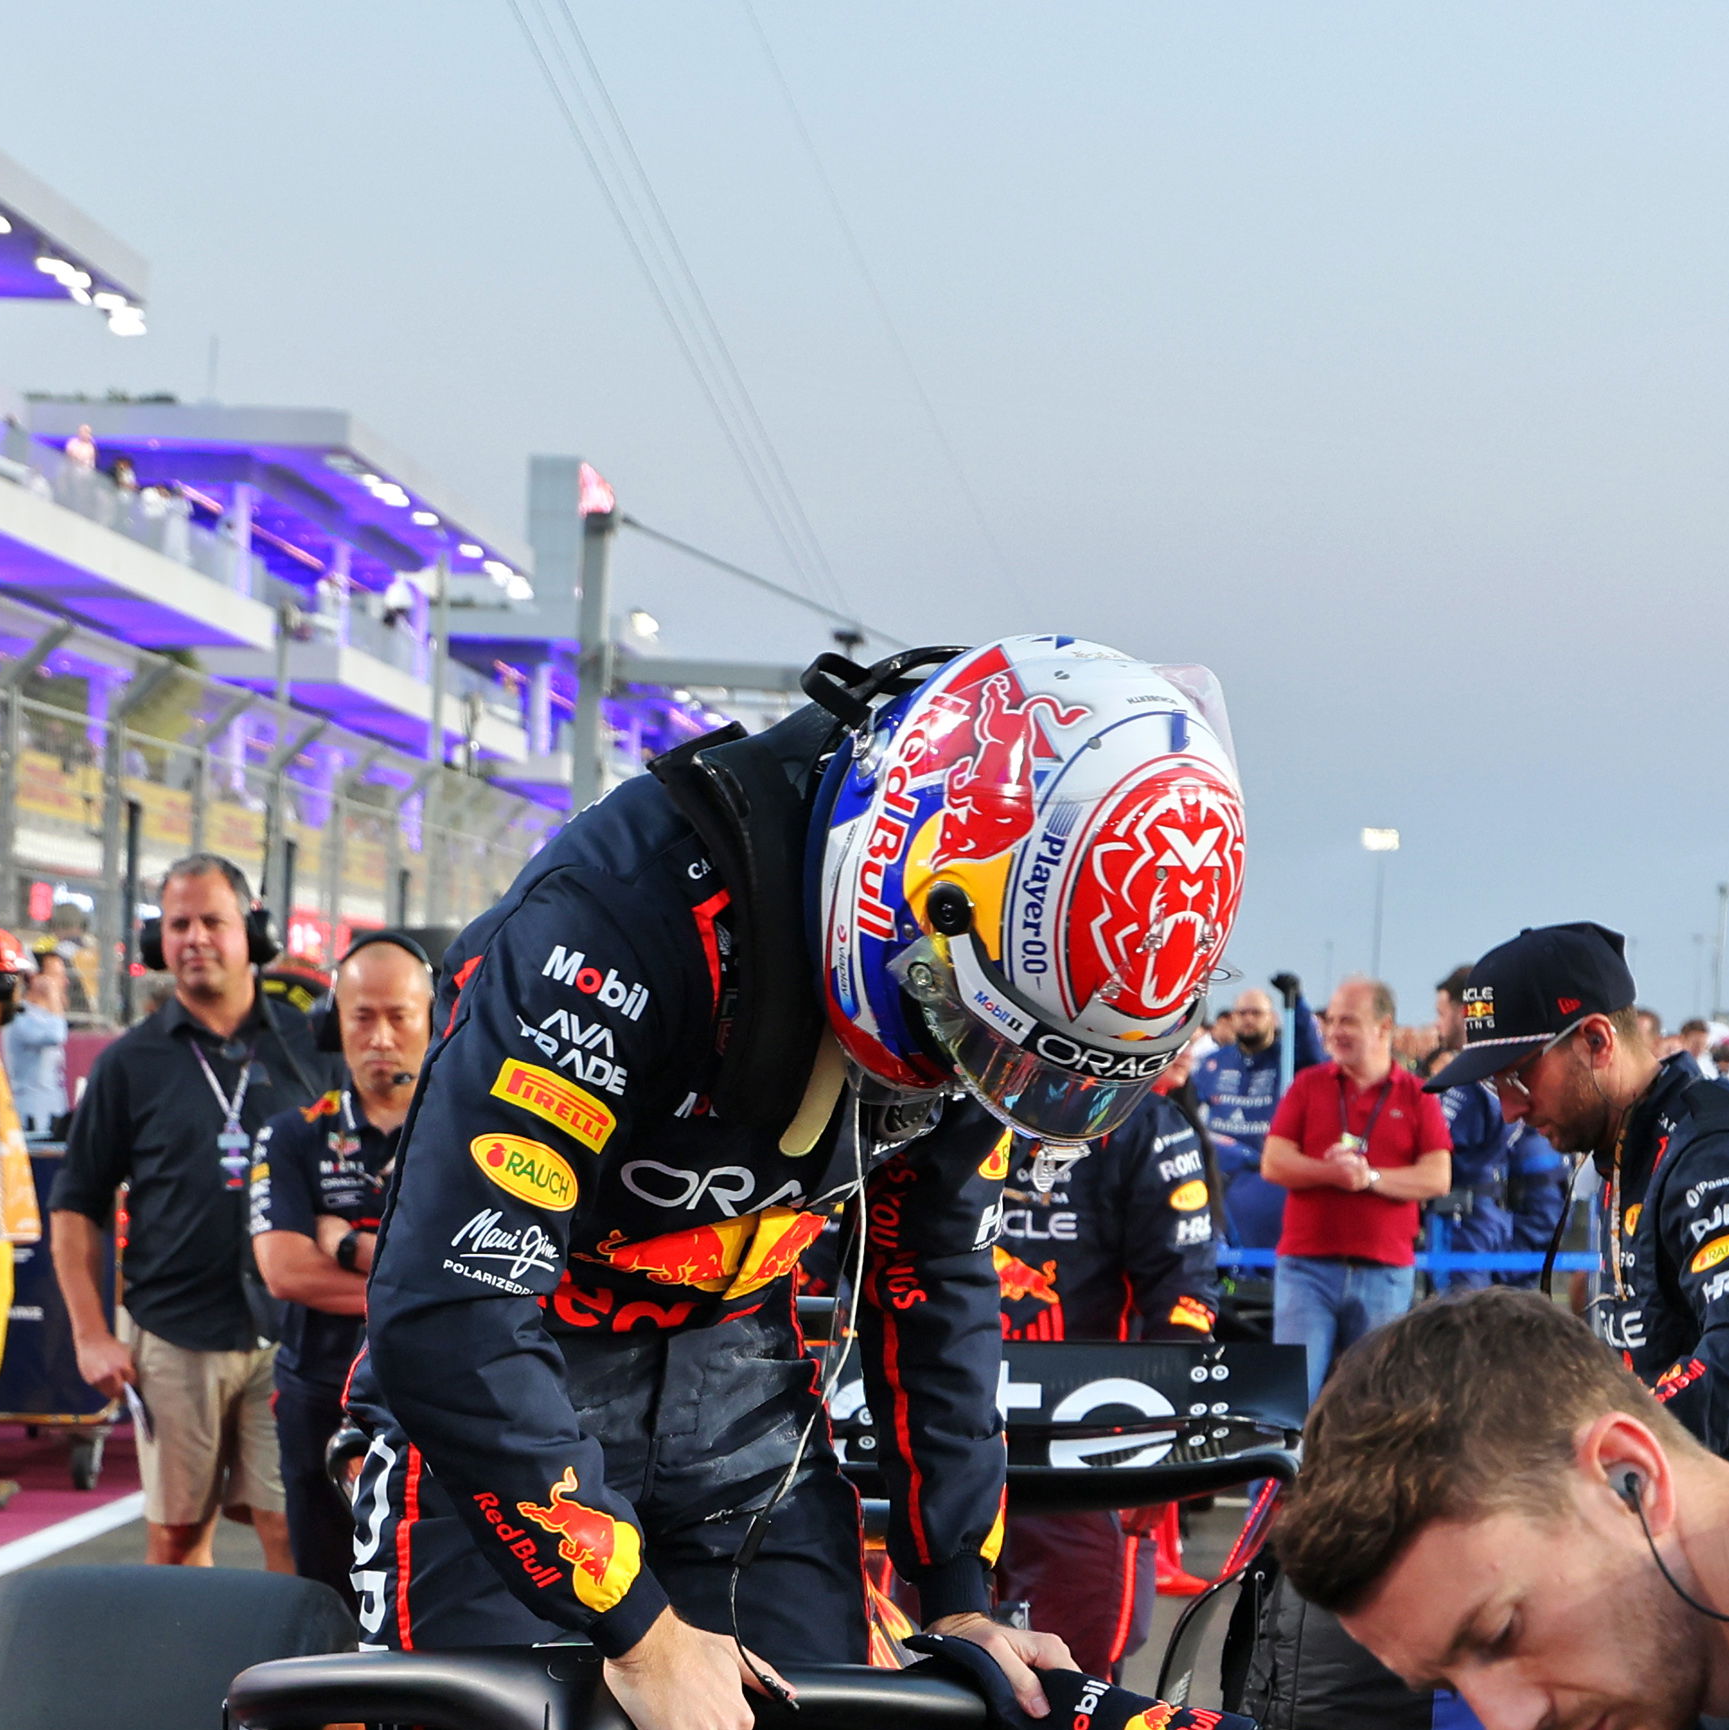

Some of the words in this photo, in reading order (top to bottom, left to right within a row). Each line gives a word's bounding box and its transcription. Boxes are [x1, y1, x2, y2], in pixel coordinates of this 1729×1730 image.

[543, 945, 651, 1023] Mobil
[539, 1008, 615, 1058] AVA
[504, 1066, 607, 1144] PIRELLI
[504, 1153, 571, 1201] RAUCH
[450, 1207, 519, 1251] Maui
[515, 1227, 561, 1277] Jim
[1000, 1211, 1080, 1240] CLE
